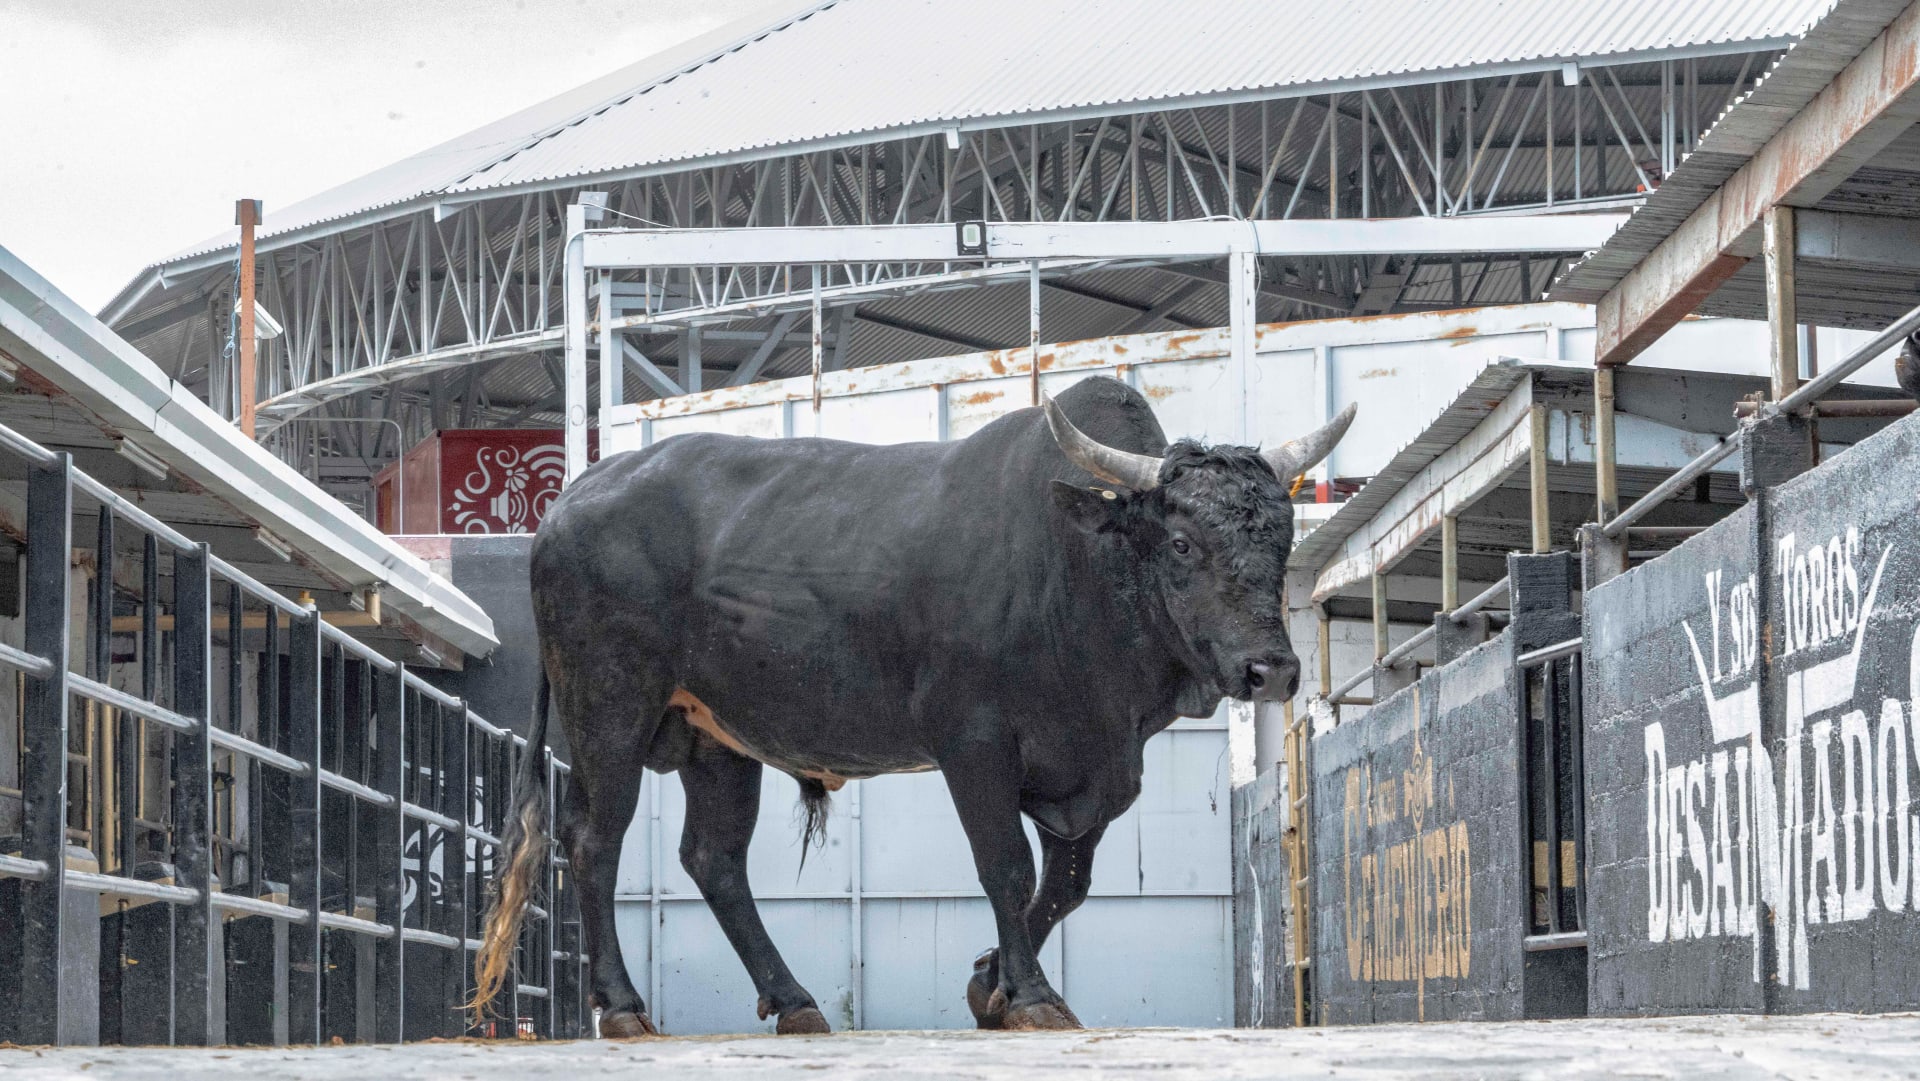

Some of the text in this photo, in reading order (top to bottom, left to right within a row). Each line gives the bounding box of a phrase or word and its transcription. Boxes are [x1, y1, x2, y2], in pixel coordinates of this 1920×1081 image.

[1705, 568, 1722, 683] Y
[1778, 526, 1860, 657] TOROS
[1644, 622, 1920, 991] DESALMADO
